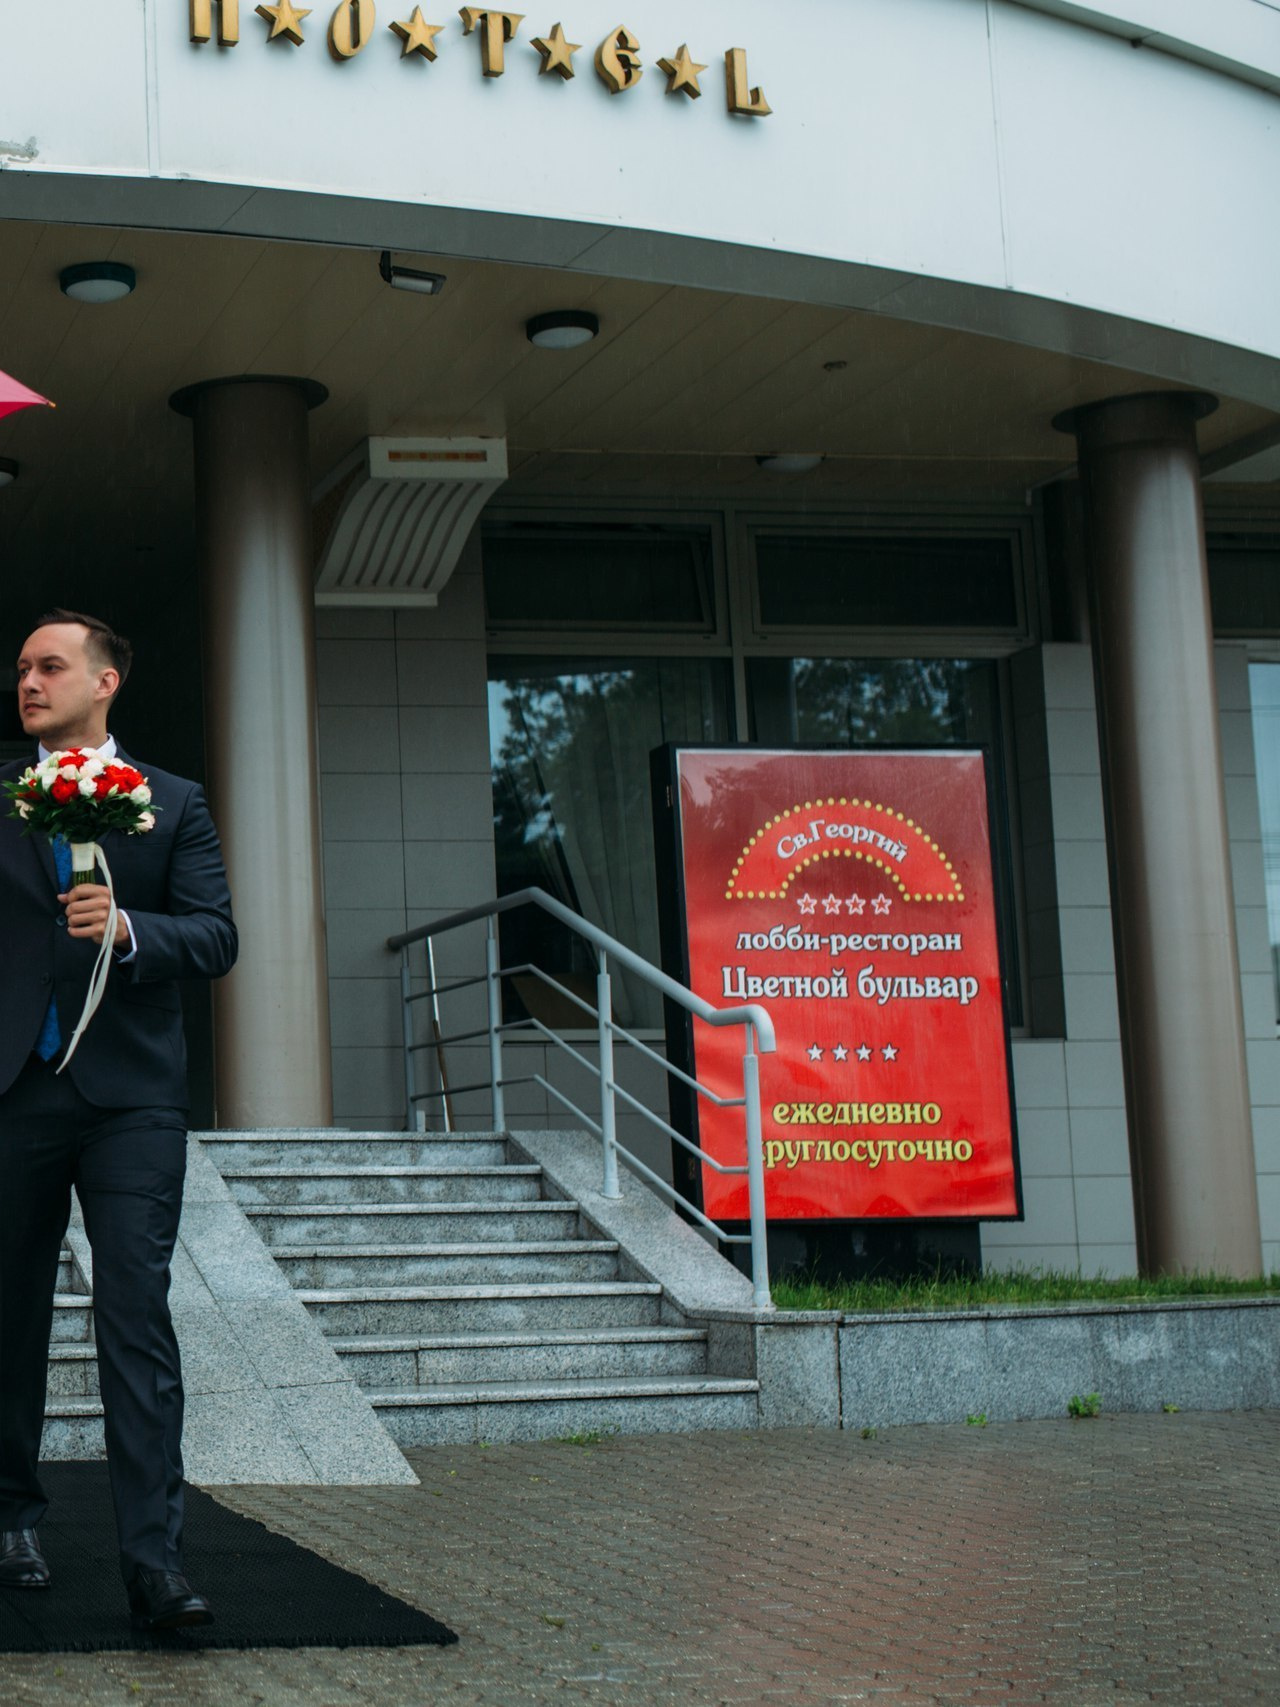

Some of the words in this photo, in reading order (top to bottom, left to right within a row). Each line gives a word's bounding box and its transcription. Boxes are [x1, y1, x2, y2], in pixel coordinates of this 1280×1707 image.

[736, 924, 962, 956] лобби-ресторан
[722, 966, 848, 1000] Цветной
[857, 964, 979, 1005] бульвар
[773, 1102, 942, 1126] ежедневно
[761, 1139, 973, 1168] руглосуточно
